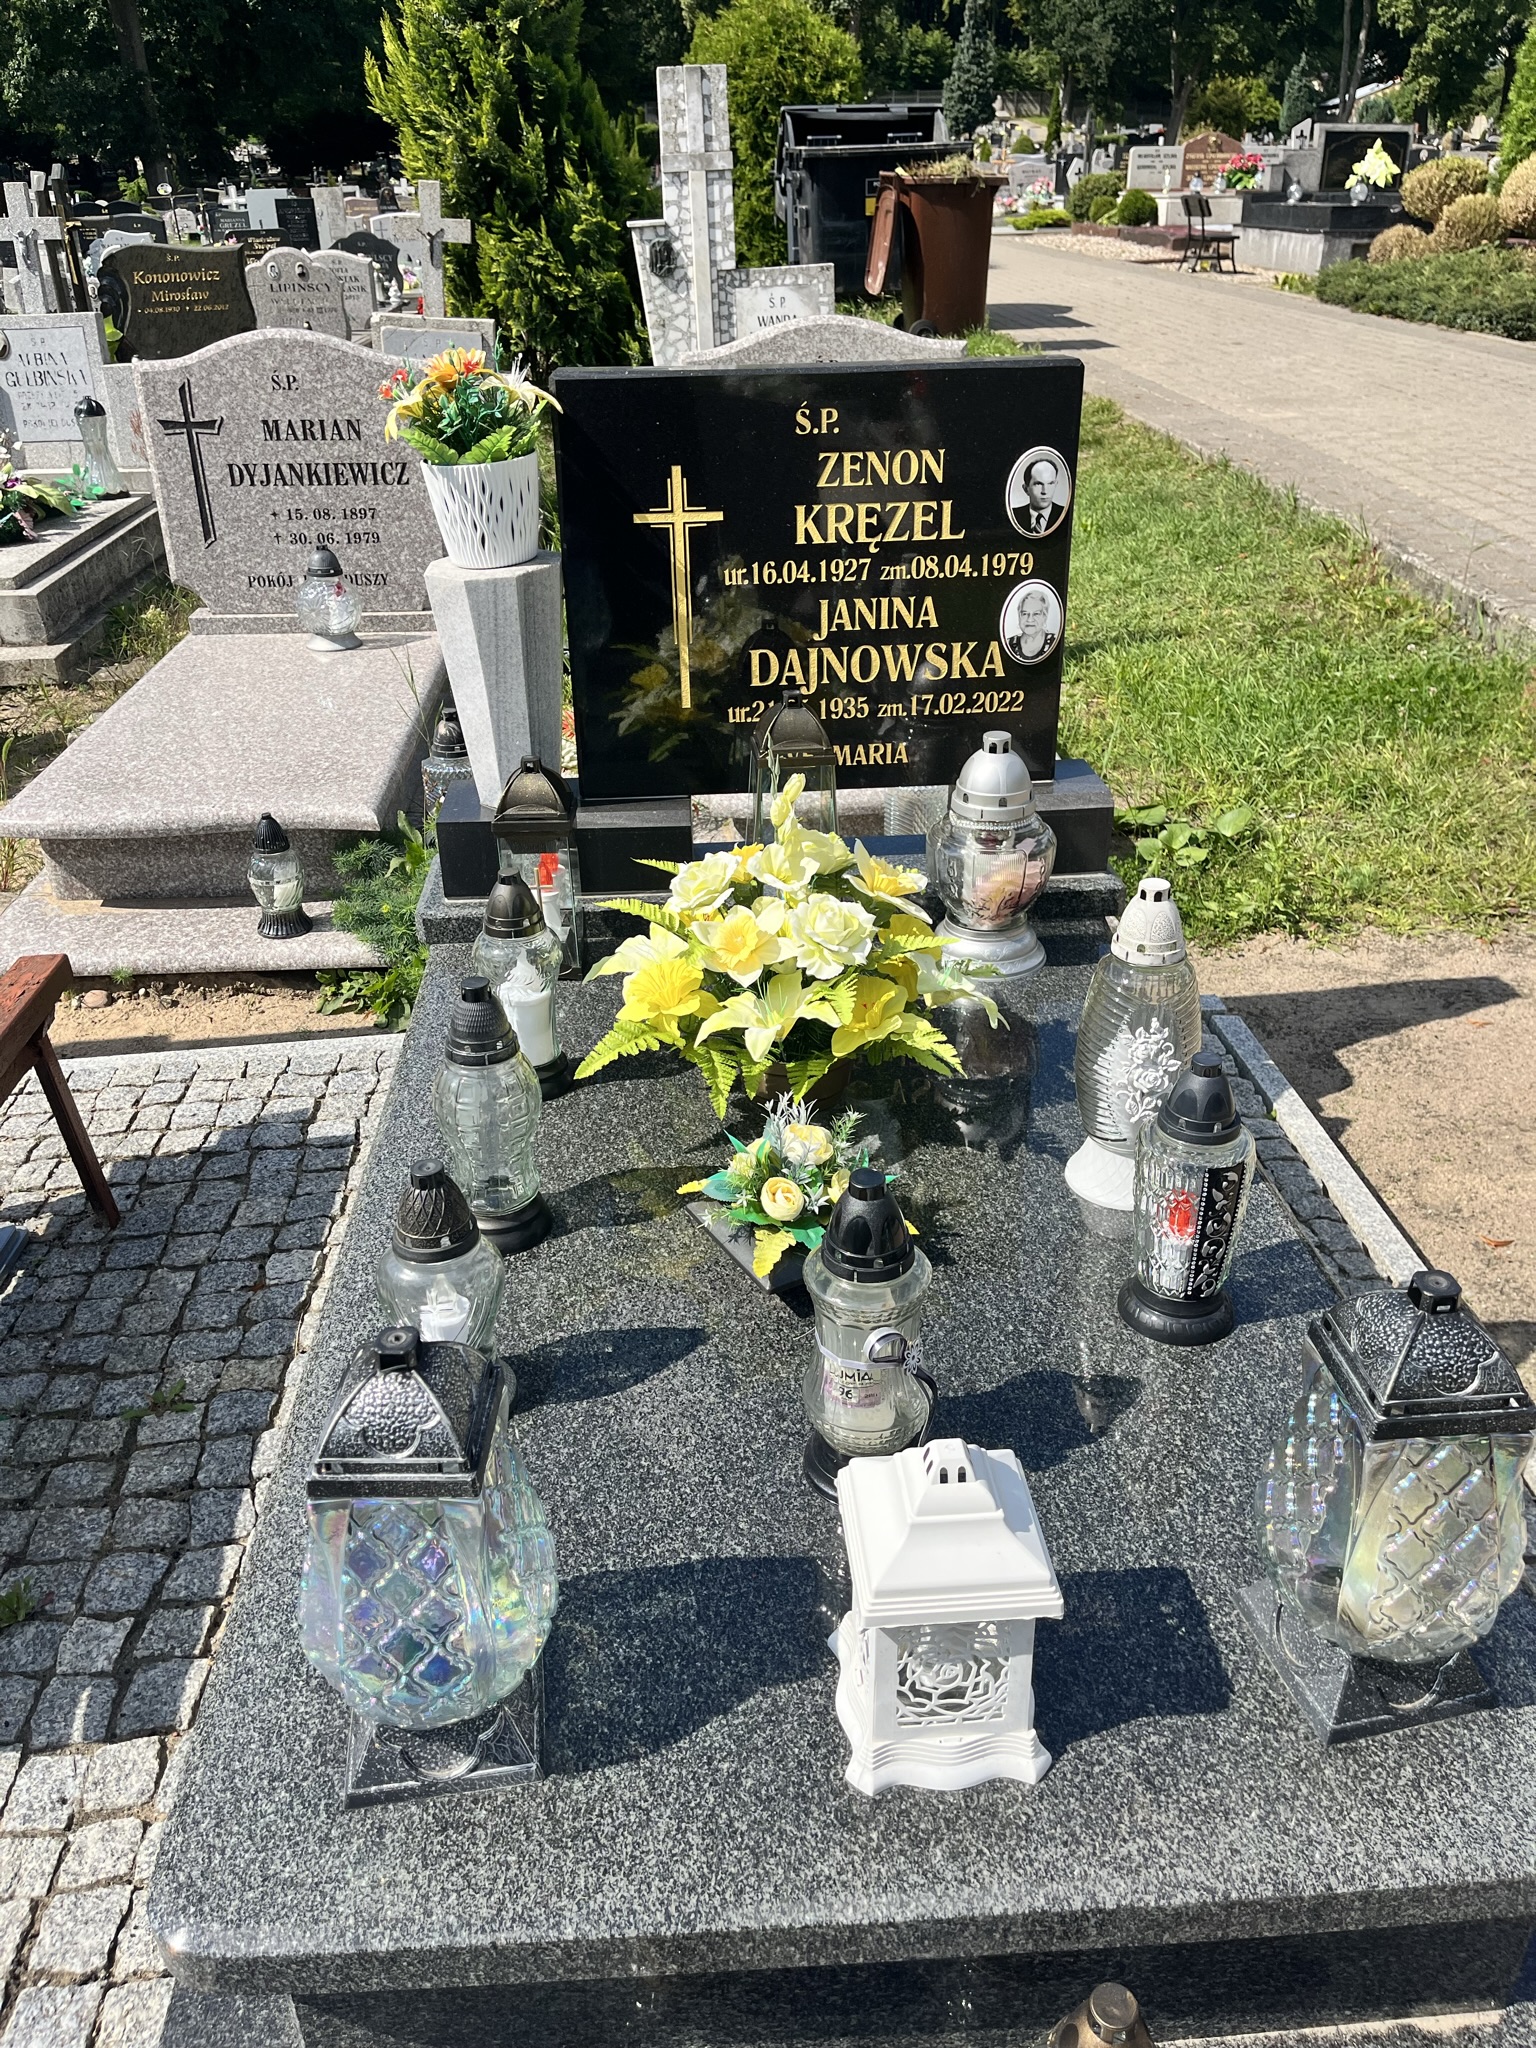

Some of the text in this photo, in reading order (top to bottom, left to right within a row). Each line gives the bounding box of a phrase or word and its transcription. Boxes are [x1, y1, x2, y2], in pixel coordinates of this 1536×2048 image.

[132, 267, 220, 285] Kononowicz
[151, 286, 210, 302] Mirosław
[271, 370, 300, 391] Ś.P.
[261, 418, 362, 441] MARIAN
[795, 401, 840, 435] Ś.P.
[227, 462, 410, 487] DYJANKIEWICZ
[816, 448, 946, 488] ZENON
[287, 508, 377, 520] 15. 08. 1897
[289, 532, 380, 545] 30. 06. 1979
[794, 500, 966, 553] KRĘZEL
[248, 572, 294, 588] POKÓJ
[723, 552, 1034, 586] ur.16.04.1927 zm.08.04.1979
[813, 595, 939, 641] JANINA
[749, 640, 1006, 695] DAJNOWSKA
[877, 690, 1025, 718] zm.17.02.2022
[833, 743, 909, 766] MARIA
